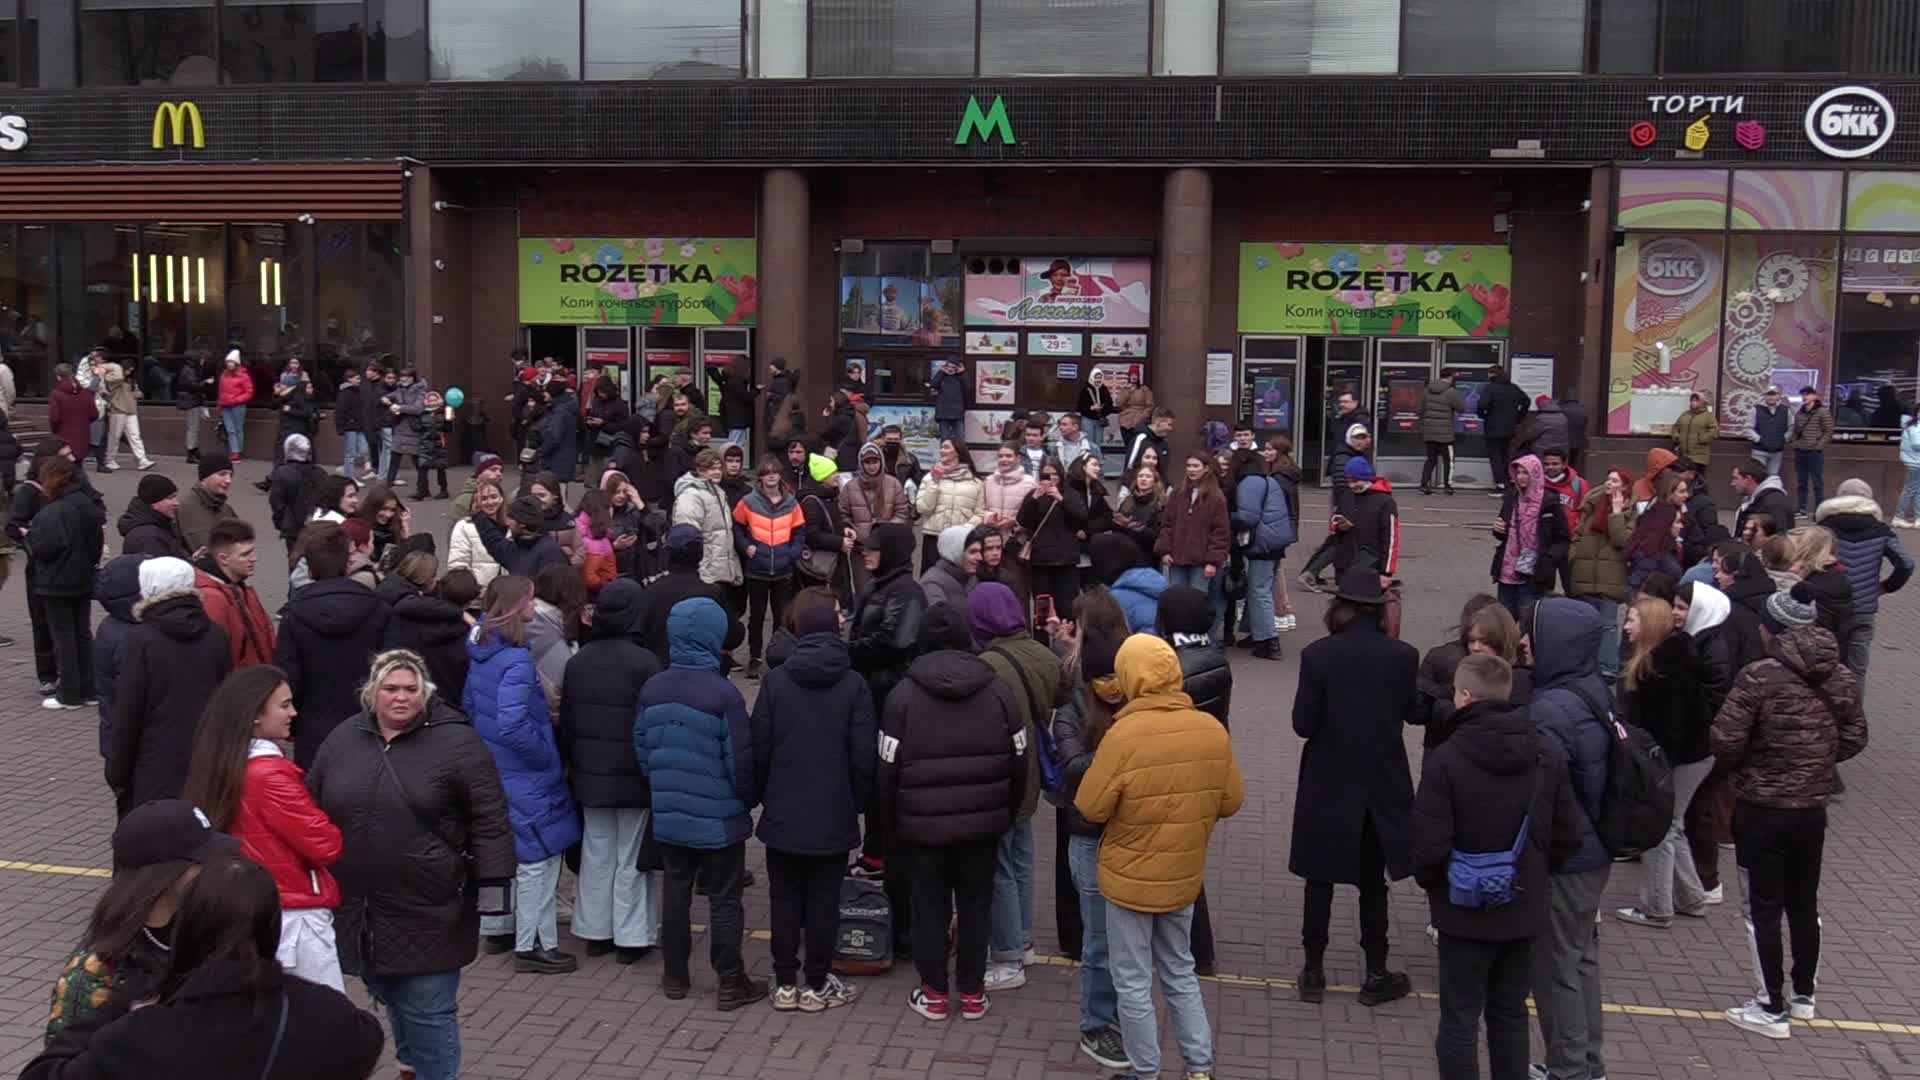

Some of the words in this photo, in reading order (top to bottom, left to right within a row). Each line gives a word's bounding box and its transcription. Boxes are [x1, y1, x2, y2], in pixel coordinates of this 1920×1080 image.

[1647, 95, 1744, 114] ТОРТИ
[954, 94, 1017, 145] М
[560, 264, 713, 283] ROZETKA
[1287, 270, 1461, 292] ROZETKA
[560, 295, 593, 309] Коли
[598, 298, 657, 310] хочеться
[1285, 304, 1323, 318] Коли
[1326, 307, 1394, 320] хочеться
[1399, 306, 1462, 323] турботи
